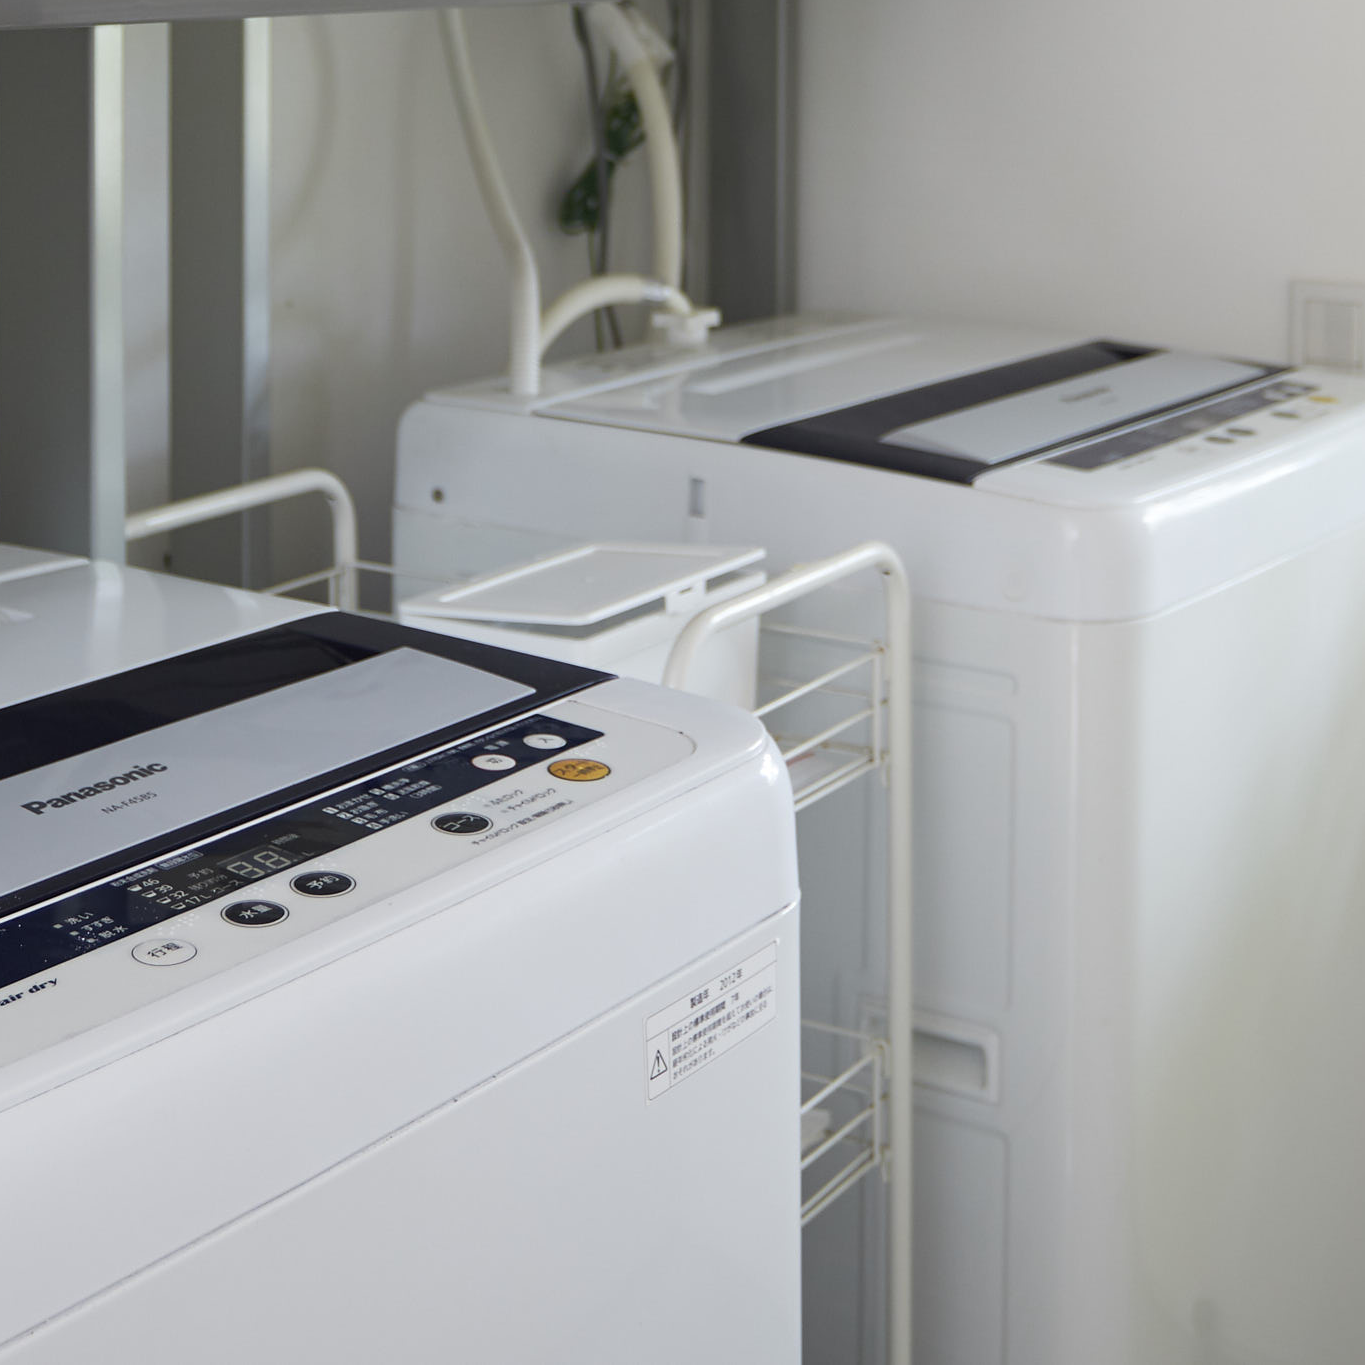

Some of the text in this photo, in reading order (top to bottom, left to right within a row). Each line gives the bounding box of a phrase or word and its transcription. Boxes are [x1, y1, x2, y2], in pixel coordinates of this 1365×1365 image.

[21, 761, 168, 815] Panasonic
[443, 815, 481, 831] コース
[142, 878, 160, 888] 46
[155, 884, 174, 894] 39
[306, 874, 340, 890] 予約
[169, 890, 189, 900] 32
[64, 912, 94, 925] 洗い
[147, 942, 183, 959] 行程
[28, 977, 58, 994] dry
